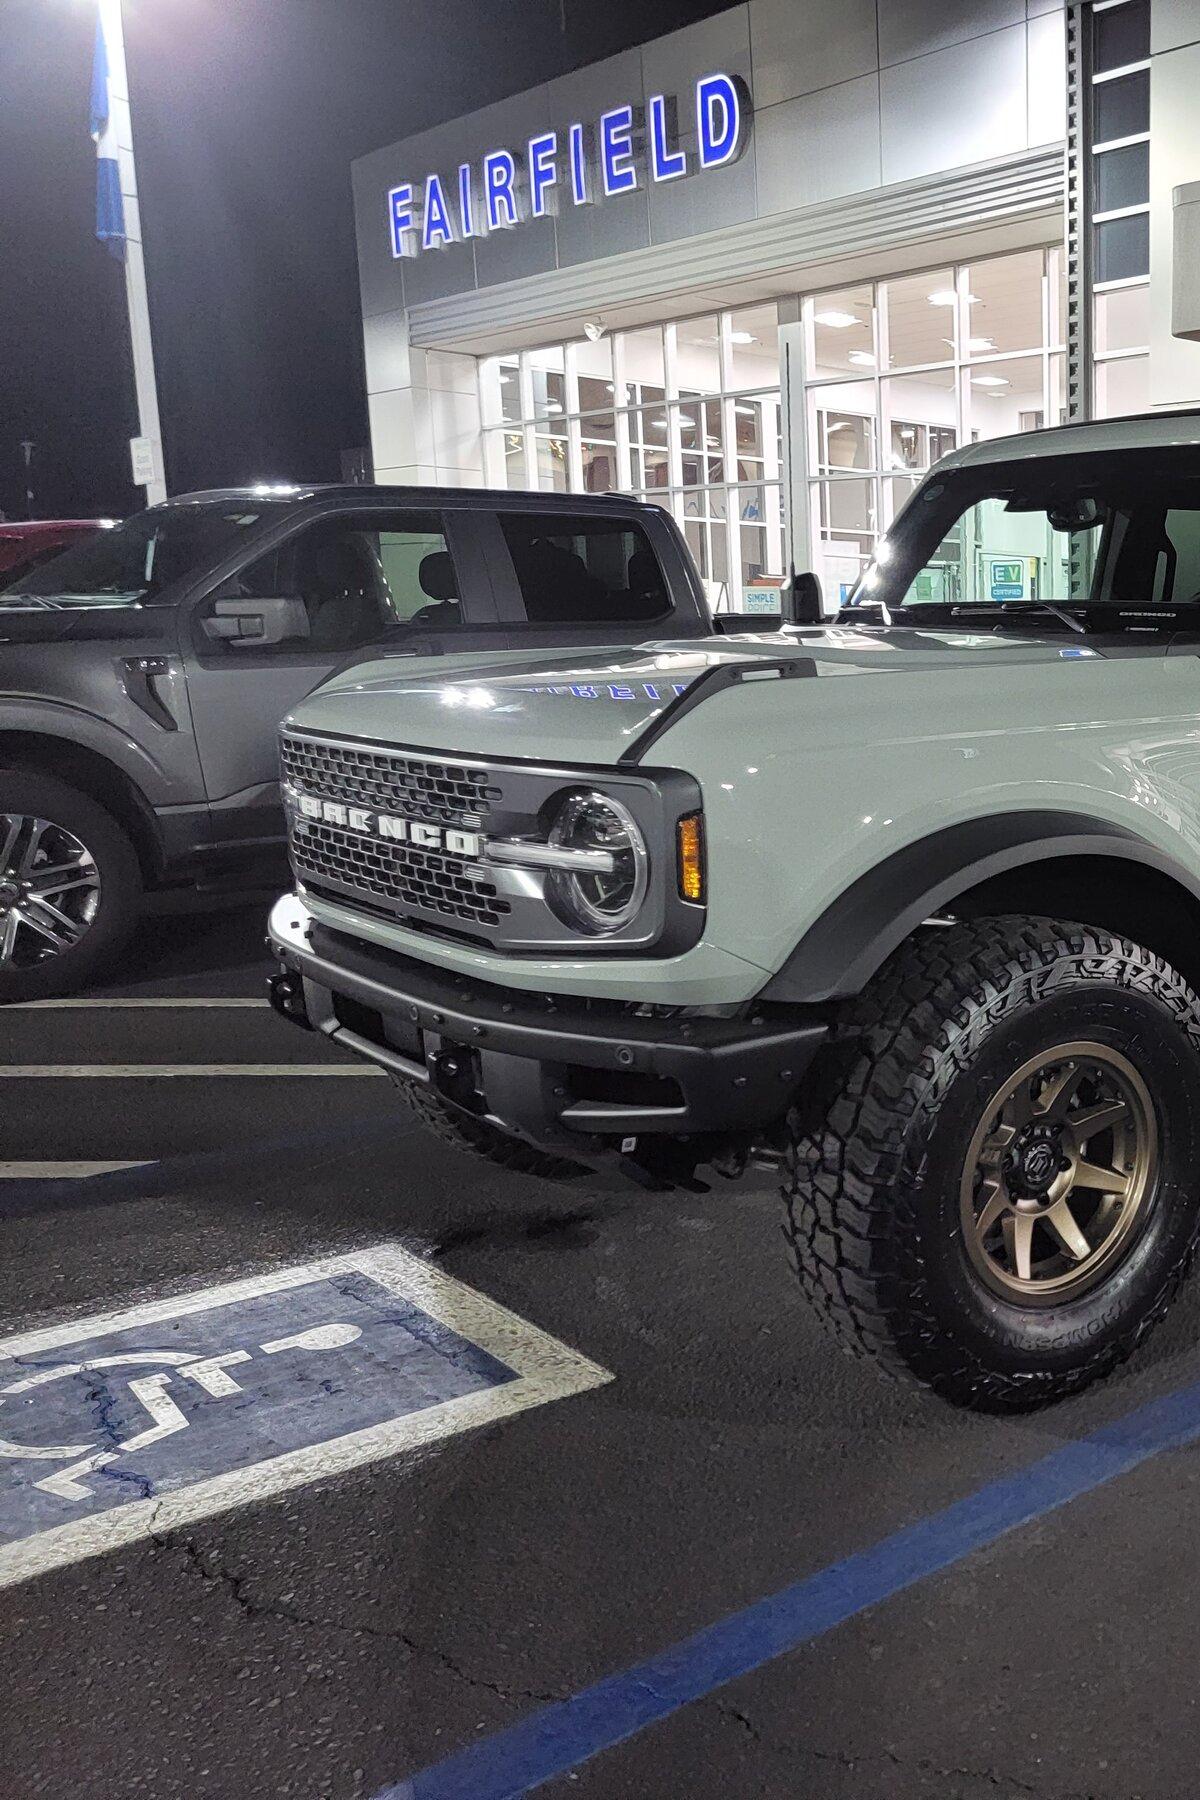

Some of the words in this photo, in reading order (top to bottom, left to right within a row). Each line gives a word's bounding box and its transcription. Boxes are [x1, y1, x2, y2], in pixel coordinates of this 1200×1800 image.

[388, 73, 740, 258] FAIRFIELD
[995, 565, 1020, 581] EV
[747, 593, 775, 603] SIMPLE
[299, 795, 479, 856] BRONCO
